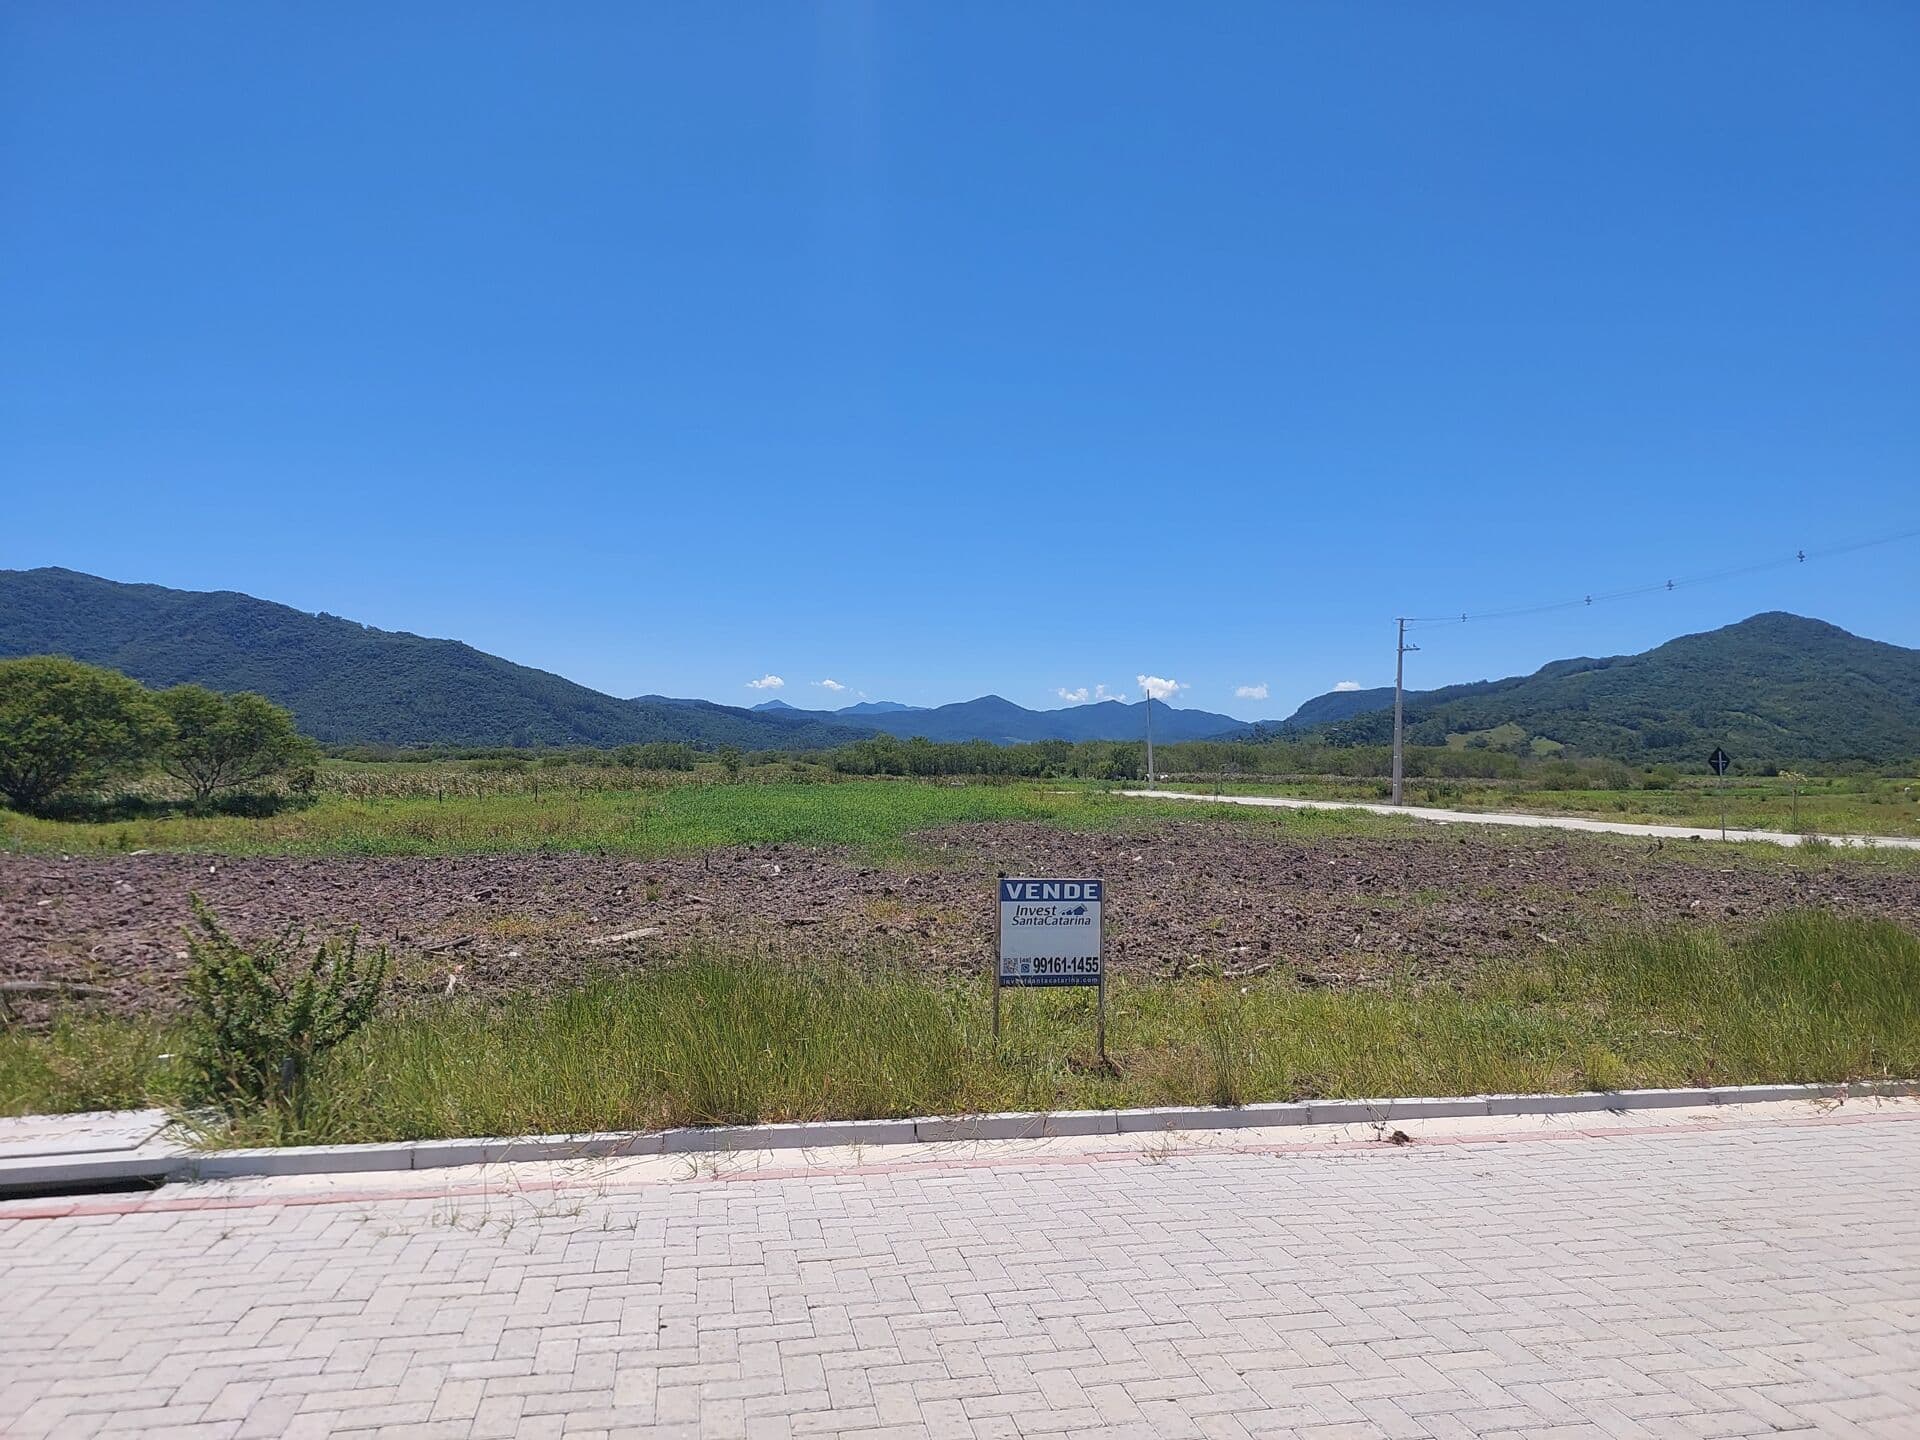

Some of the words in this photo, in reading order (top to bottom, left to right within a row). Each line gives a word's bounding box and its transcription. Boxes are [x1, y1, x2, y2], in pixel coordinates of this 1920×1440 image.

[1006, 883, 1098, 899] VENDE
[1016, 905, 1057, 916] Invest
[1012, 916, 1091, 926] SantaCatarina
[1033, 957, 1099, 973] 99161-1455
[1003, 976, 1098, 985] invtsantacatarina.com
